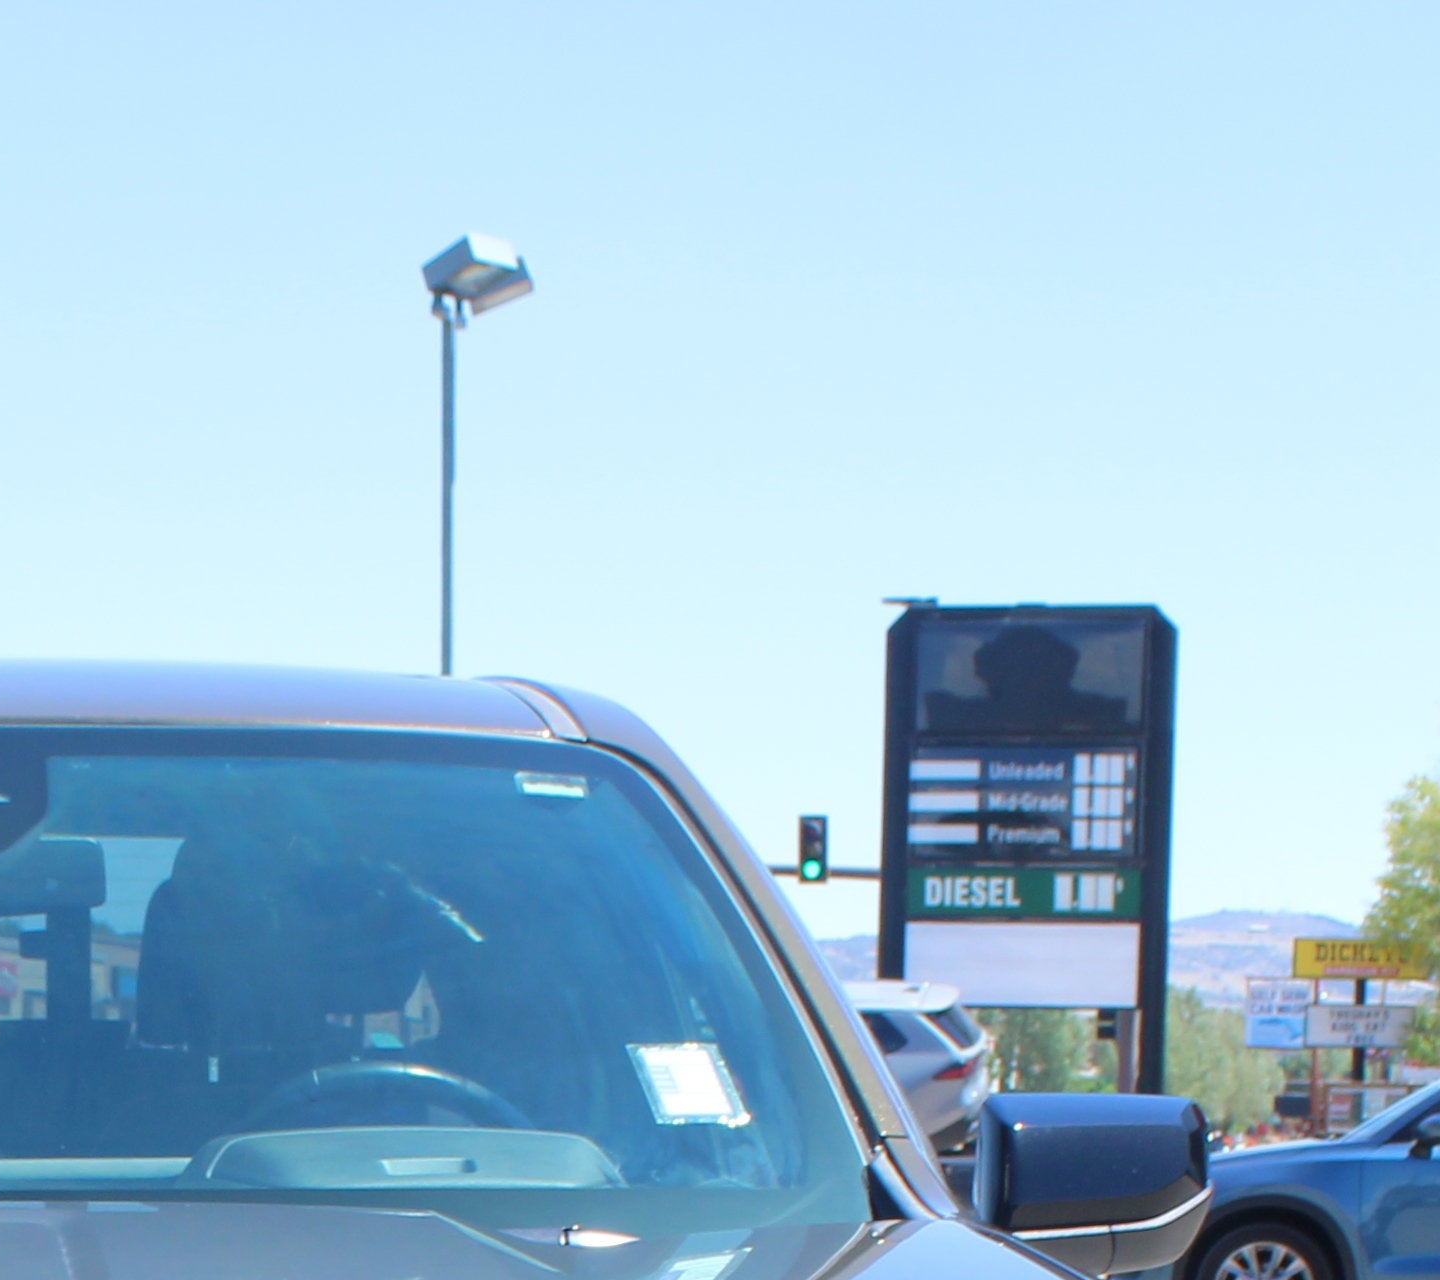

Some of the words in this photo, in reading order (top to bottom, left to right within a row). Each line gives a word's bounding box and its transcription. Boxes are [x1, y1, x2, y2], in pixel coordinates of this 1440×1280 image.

[988, 761, 1064, 780] Unleaded
[987, 823, 1061, 844] Premium
[924, 876, 1021, 908] DIESEL
